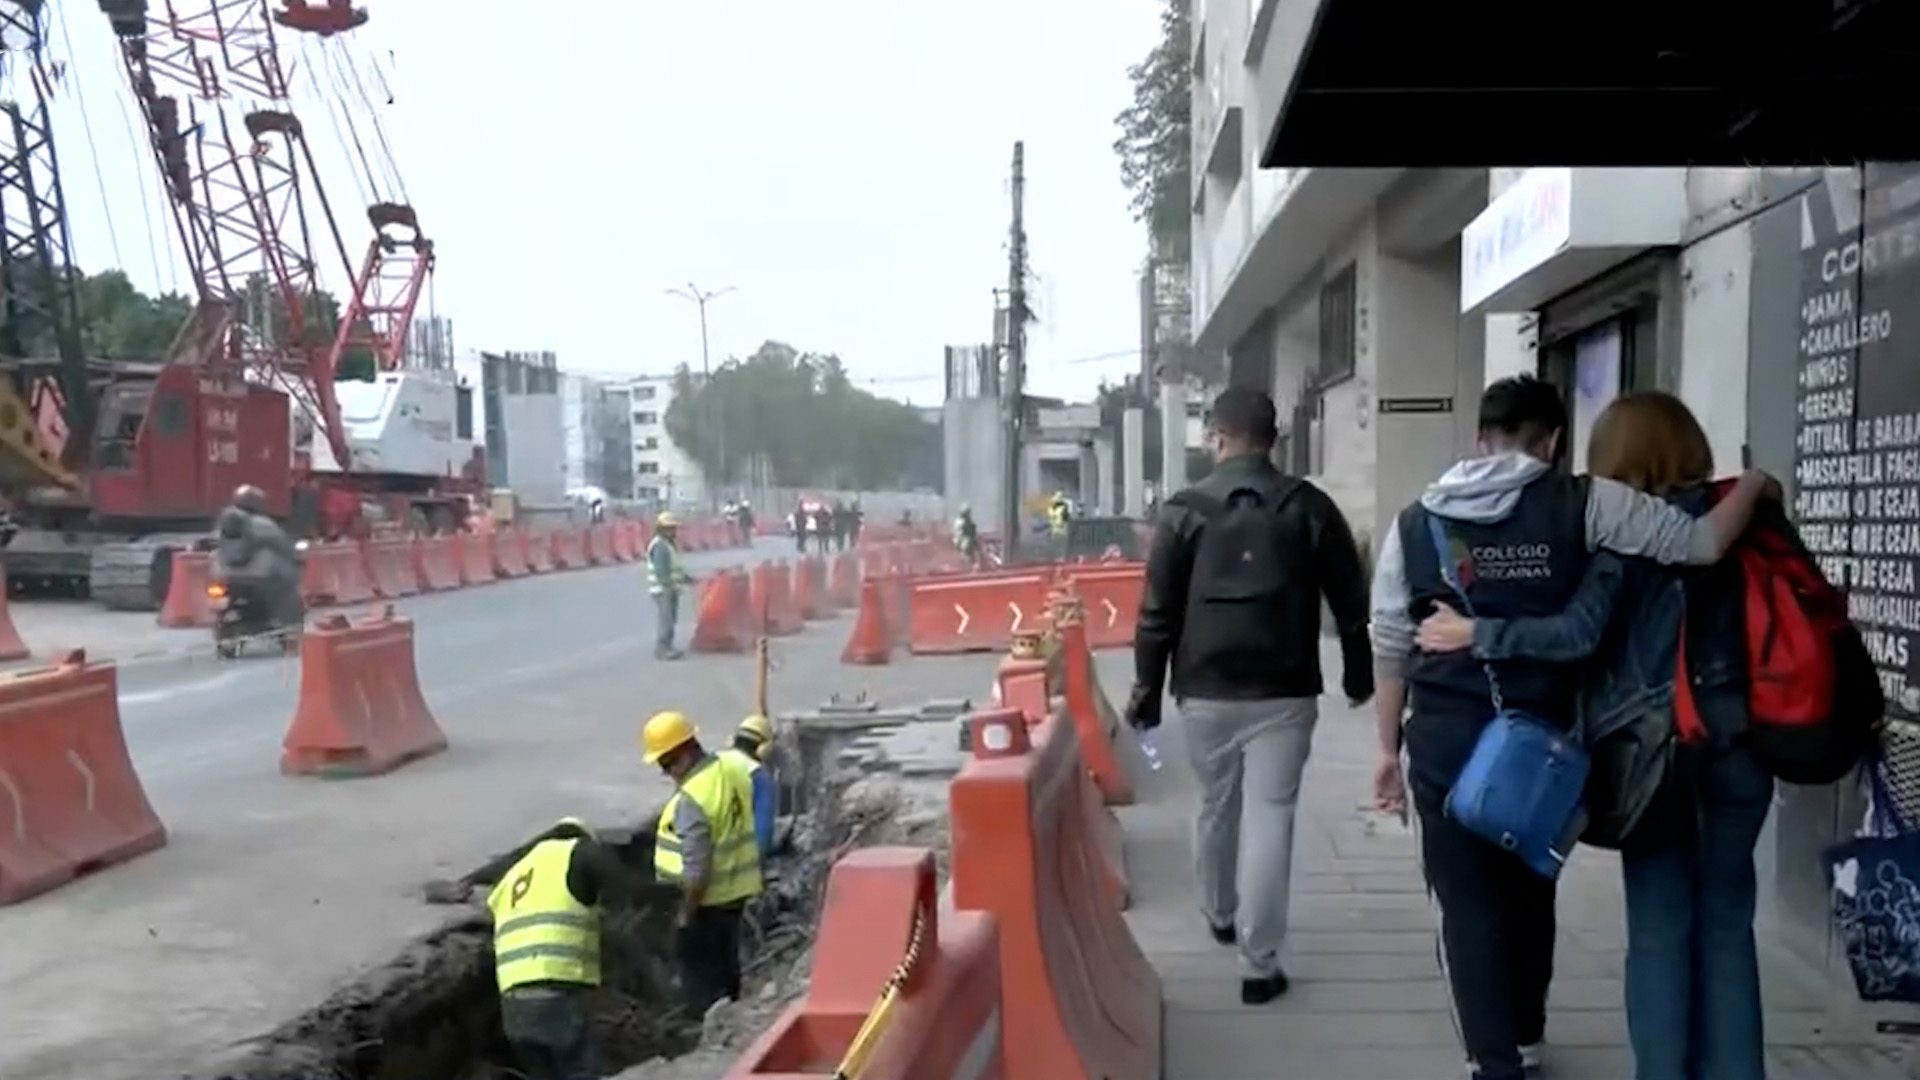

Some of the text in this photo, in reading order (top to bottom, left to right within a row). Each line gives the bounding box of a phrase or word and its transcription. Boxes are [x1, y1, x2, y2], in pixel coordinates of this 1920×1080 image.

[1808, 288, 1852, 325] DAMA
[1808, 309, 1891, 355] CABALLERO
[1806, 355, 1848, 389] NIÑOS
[1805, 388, 1853, 420] GRECAS
[1803, 421, 1849, 454] RITUAL
[1800, 487, 1866, 519] PLANCHAO
[1472, 543, 1552, 560] COLEGIO
[1880, 559, 1915, 592] CEJA
